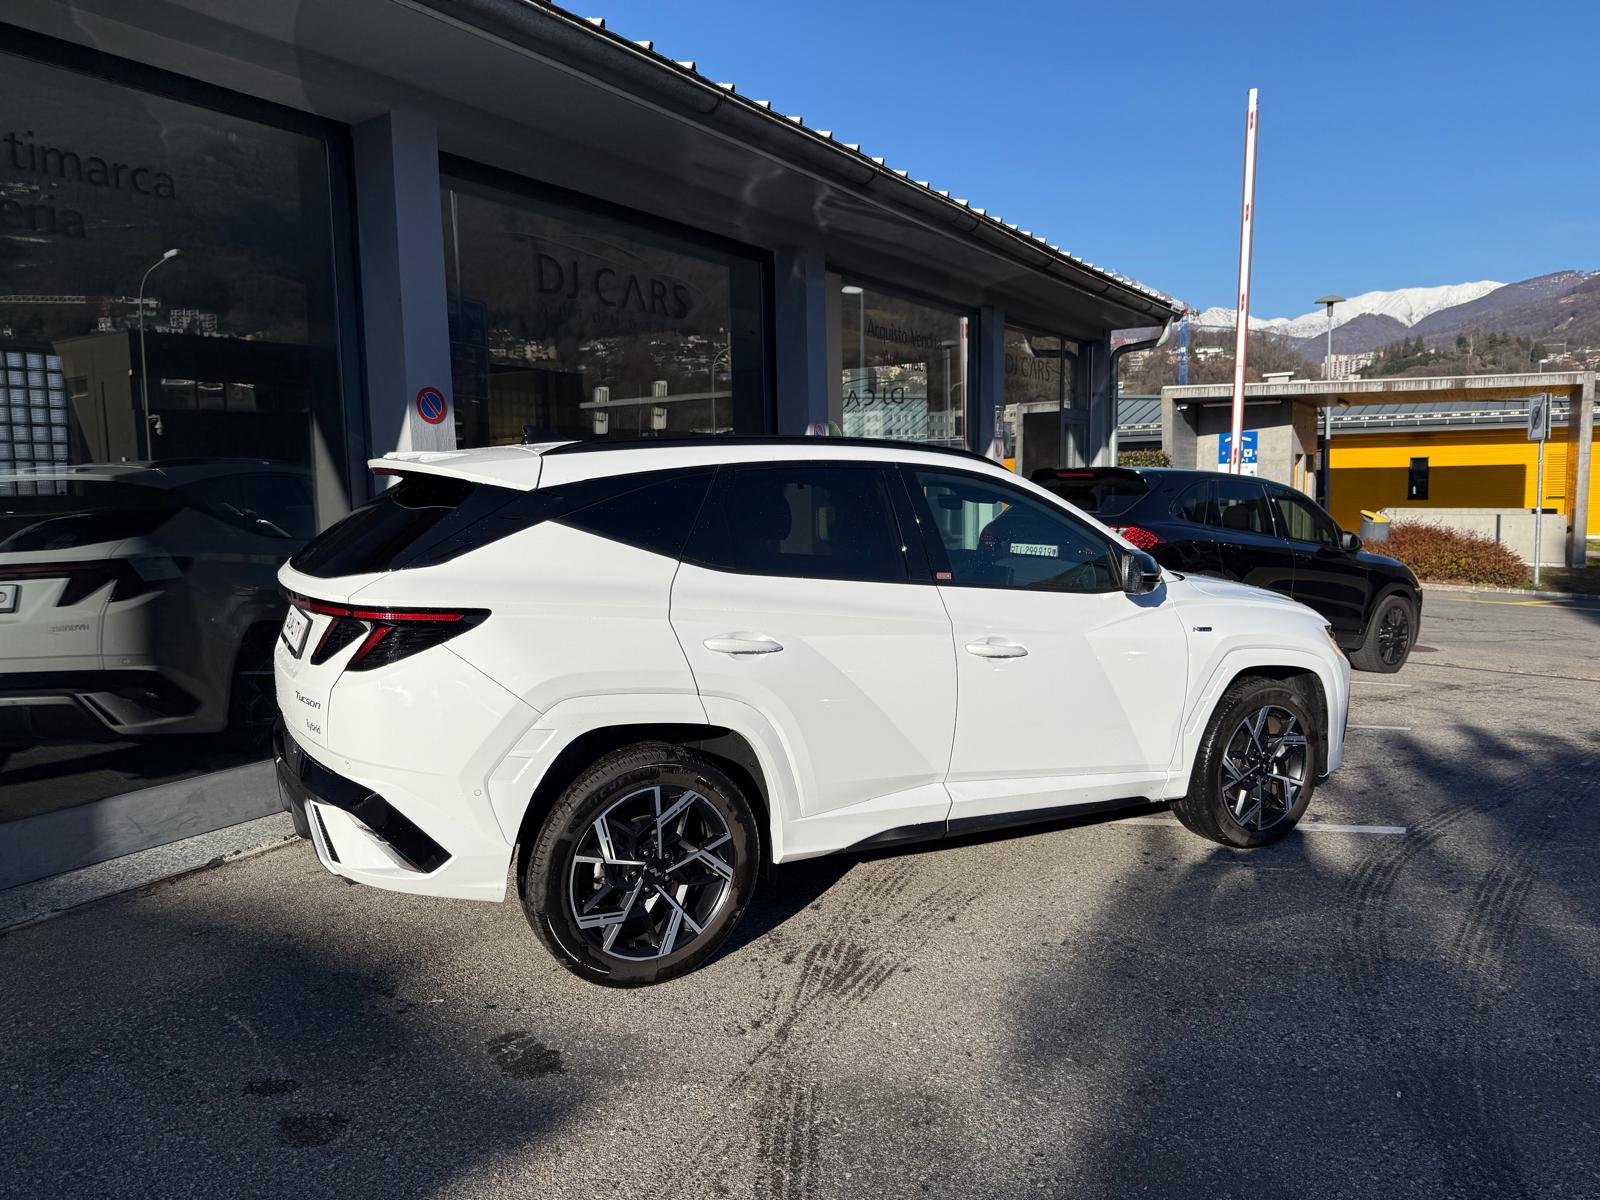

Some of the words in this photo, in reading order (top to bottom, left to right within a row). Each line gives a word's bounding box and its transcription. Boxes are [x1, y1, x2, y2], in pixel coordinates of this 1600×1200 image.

[535, 252, 581, 300] DJ
[592, 267, 693, 320] CARS
[1005, 351, 1018, 375] DJ
[1021, 356, 1051, 383] CARS
